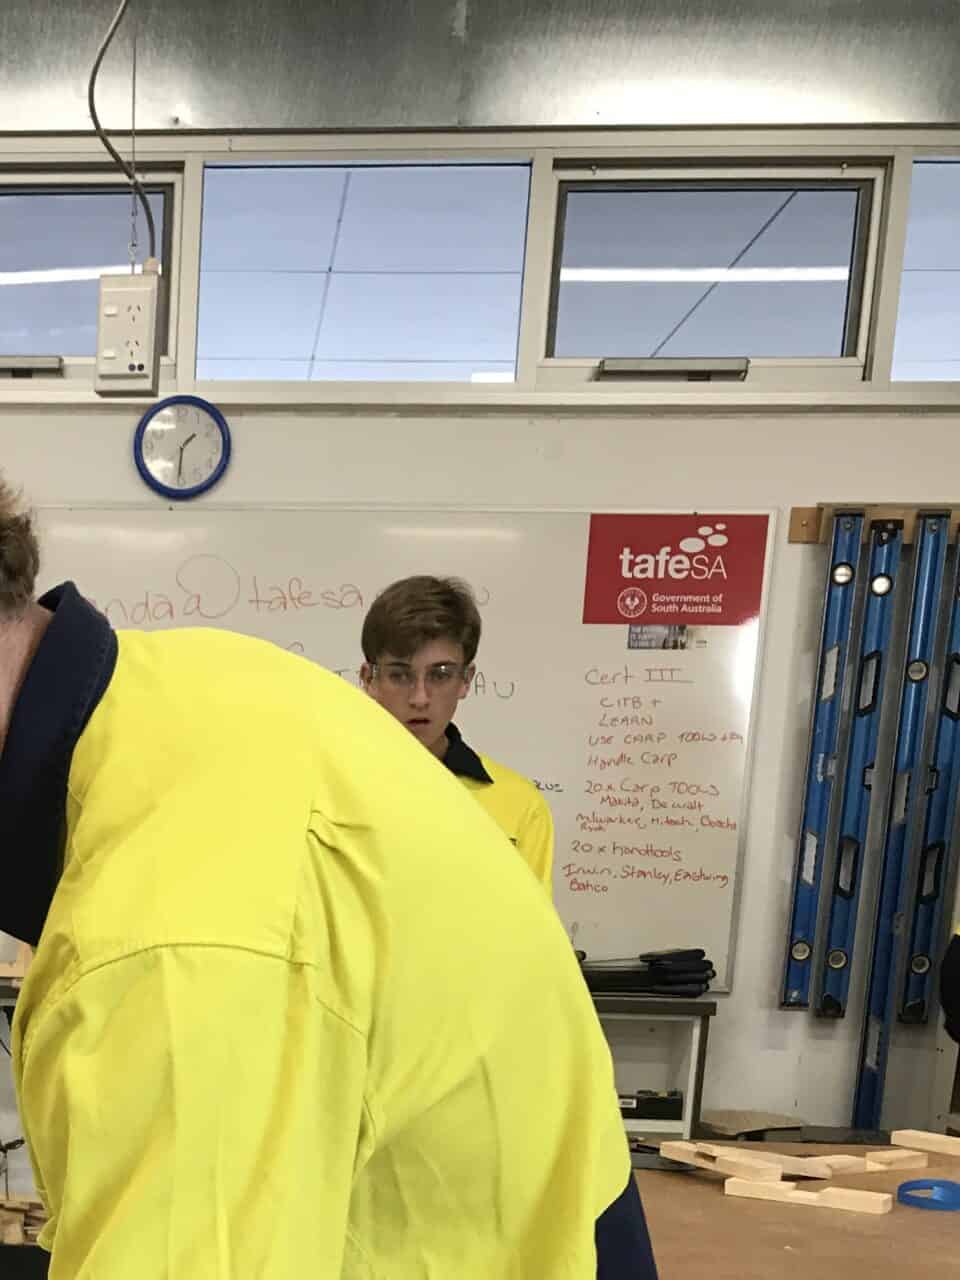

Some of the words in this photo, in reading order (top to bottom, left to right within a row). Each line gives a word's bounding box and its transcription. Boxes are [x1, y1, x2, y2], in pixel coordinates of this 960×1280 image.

[618, 546, 728, 580] tafeSA
[651, 592, 711, 603] Government
[712, 593, 724, 603] of
[651, 603, 679, 614] South
[680, 603, 723, 614] Australia
[584, 664, 635, 685] Cert
[599, 696, 642, 709] CITB
[640, 752, 678, 768] Carp
[619, 777, 661, 797] Carp
